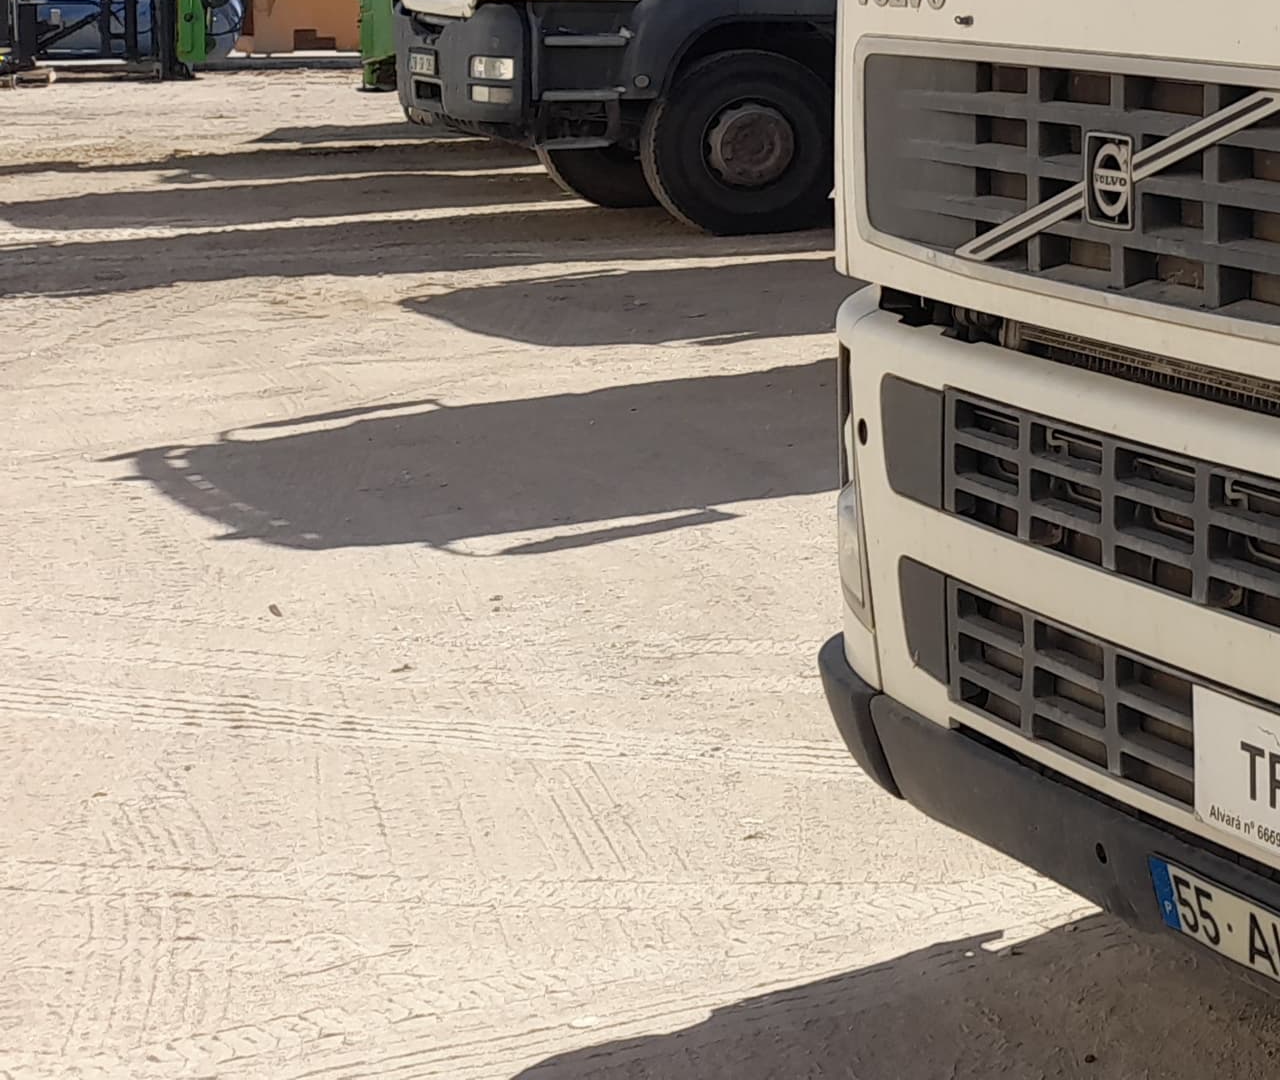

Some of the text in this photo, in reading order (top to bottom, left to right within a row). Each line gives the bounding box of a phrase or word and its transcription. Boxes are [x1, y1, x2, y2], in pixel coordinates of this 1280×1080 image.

[1094, 173, 1128, 187] VOLVO
[1209, 804, 1241, 831] Alvará
[1164, 899, 1173, 916] P
